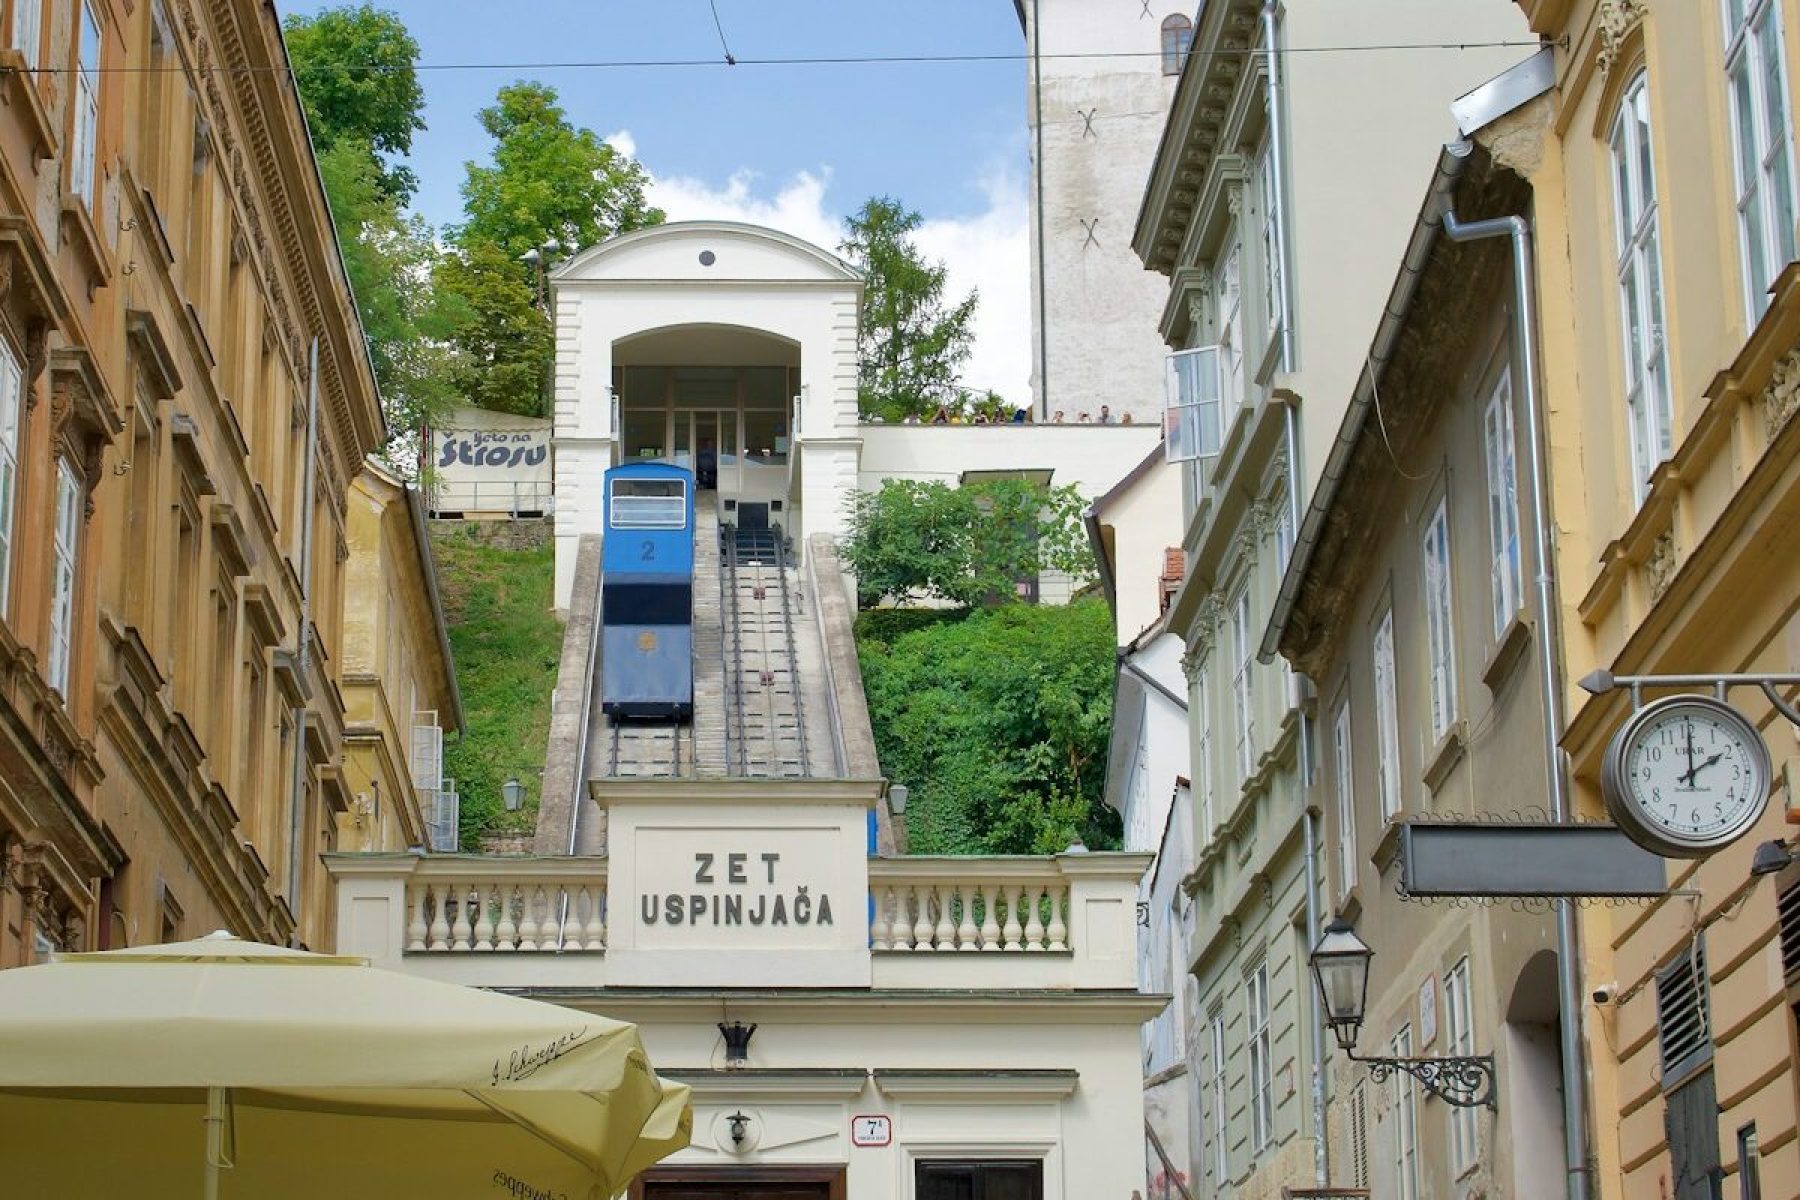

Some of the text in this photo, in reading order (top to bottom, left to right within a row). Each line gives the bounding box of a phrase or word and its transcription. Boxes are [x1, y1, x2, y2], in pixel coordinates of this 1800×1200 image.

[511, 434, 531, 443] na
[641, 540, 655, 561] 2
[1661, 730, 1673, 745] 11
[1711, 728, 1715, 744] 1
[1646, 748, 1661, 762] 10
[1724, 744, 1732, 759] 2
[1642, 767, 1651, 781] 9
[1732, 765, 1740, 780] 3
[1652, 787, 1661, 802] 8
[1726, 786, 1735, 801] 4
[1669, 804, 1677, 819] 7
[1691, 808, 1700, 823] 6
[1715, 802, 1723, 818] 5
[695, 853, 780, 883] ZET
[641, 886, 833, 925] USPINJAČA
